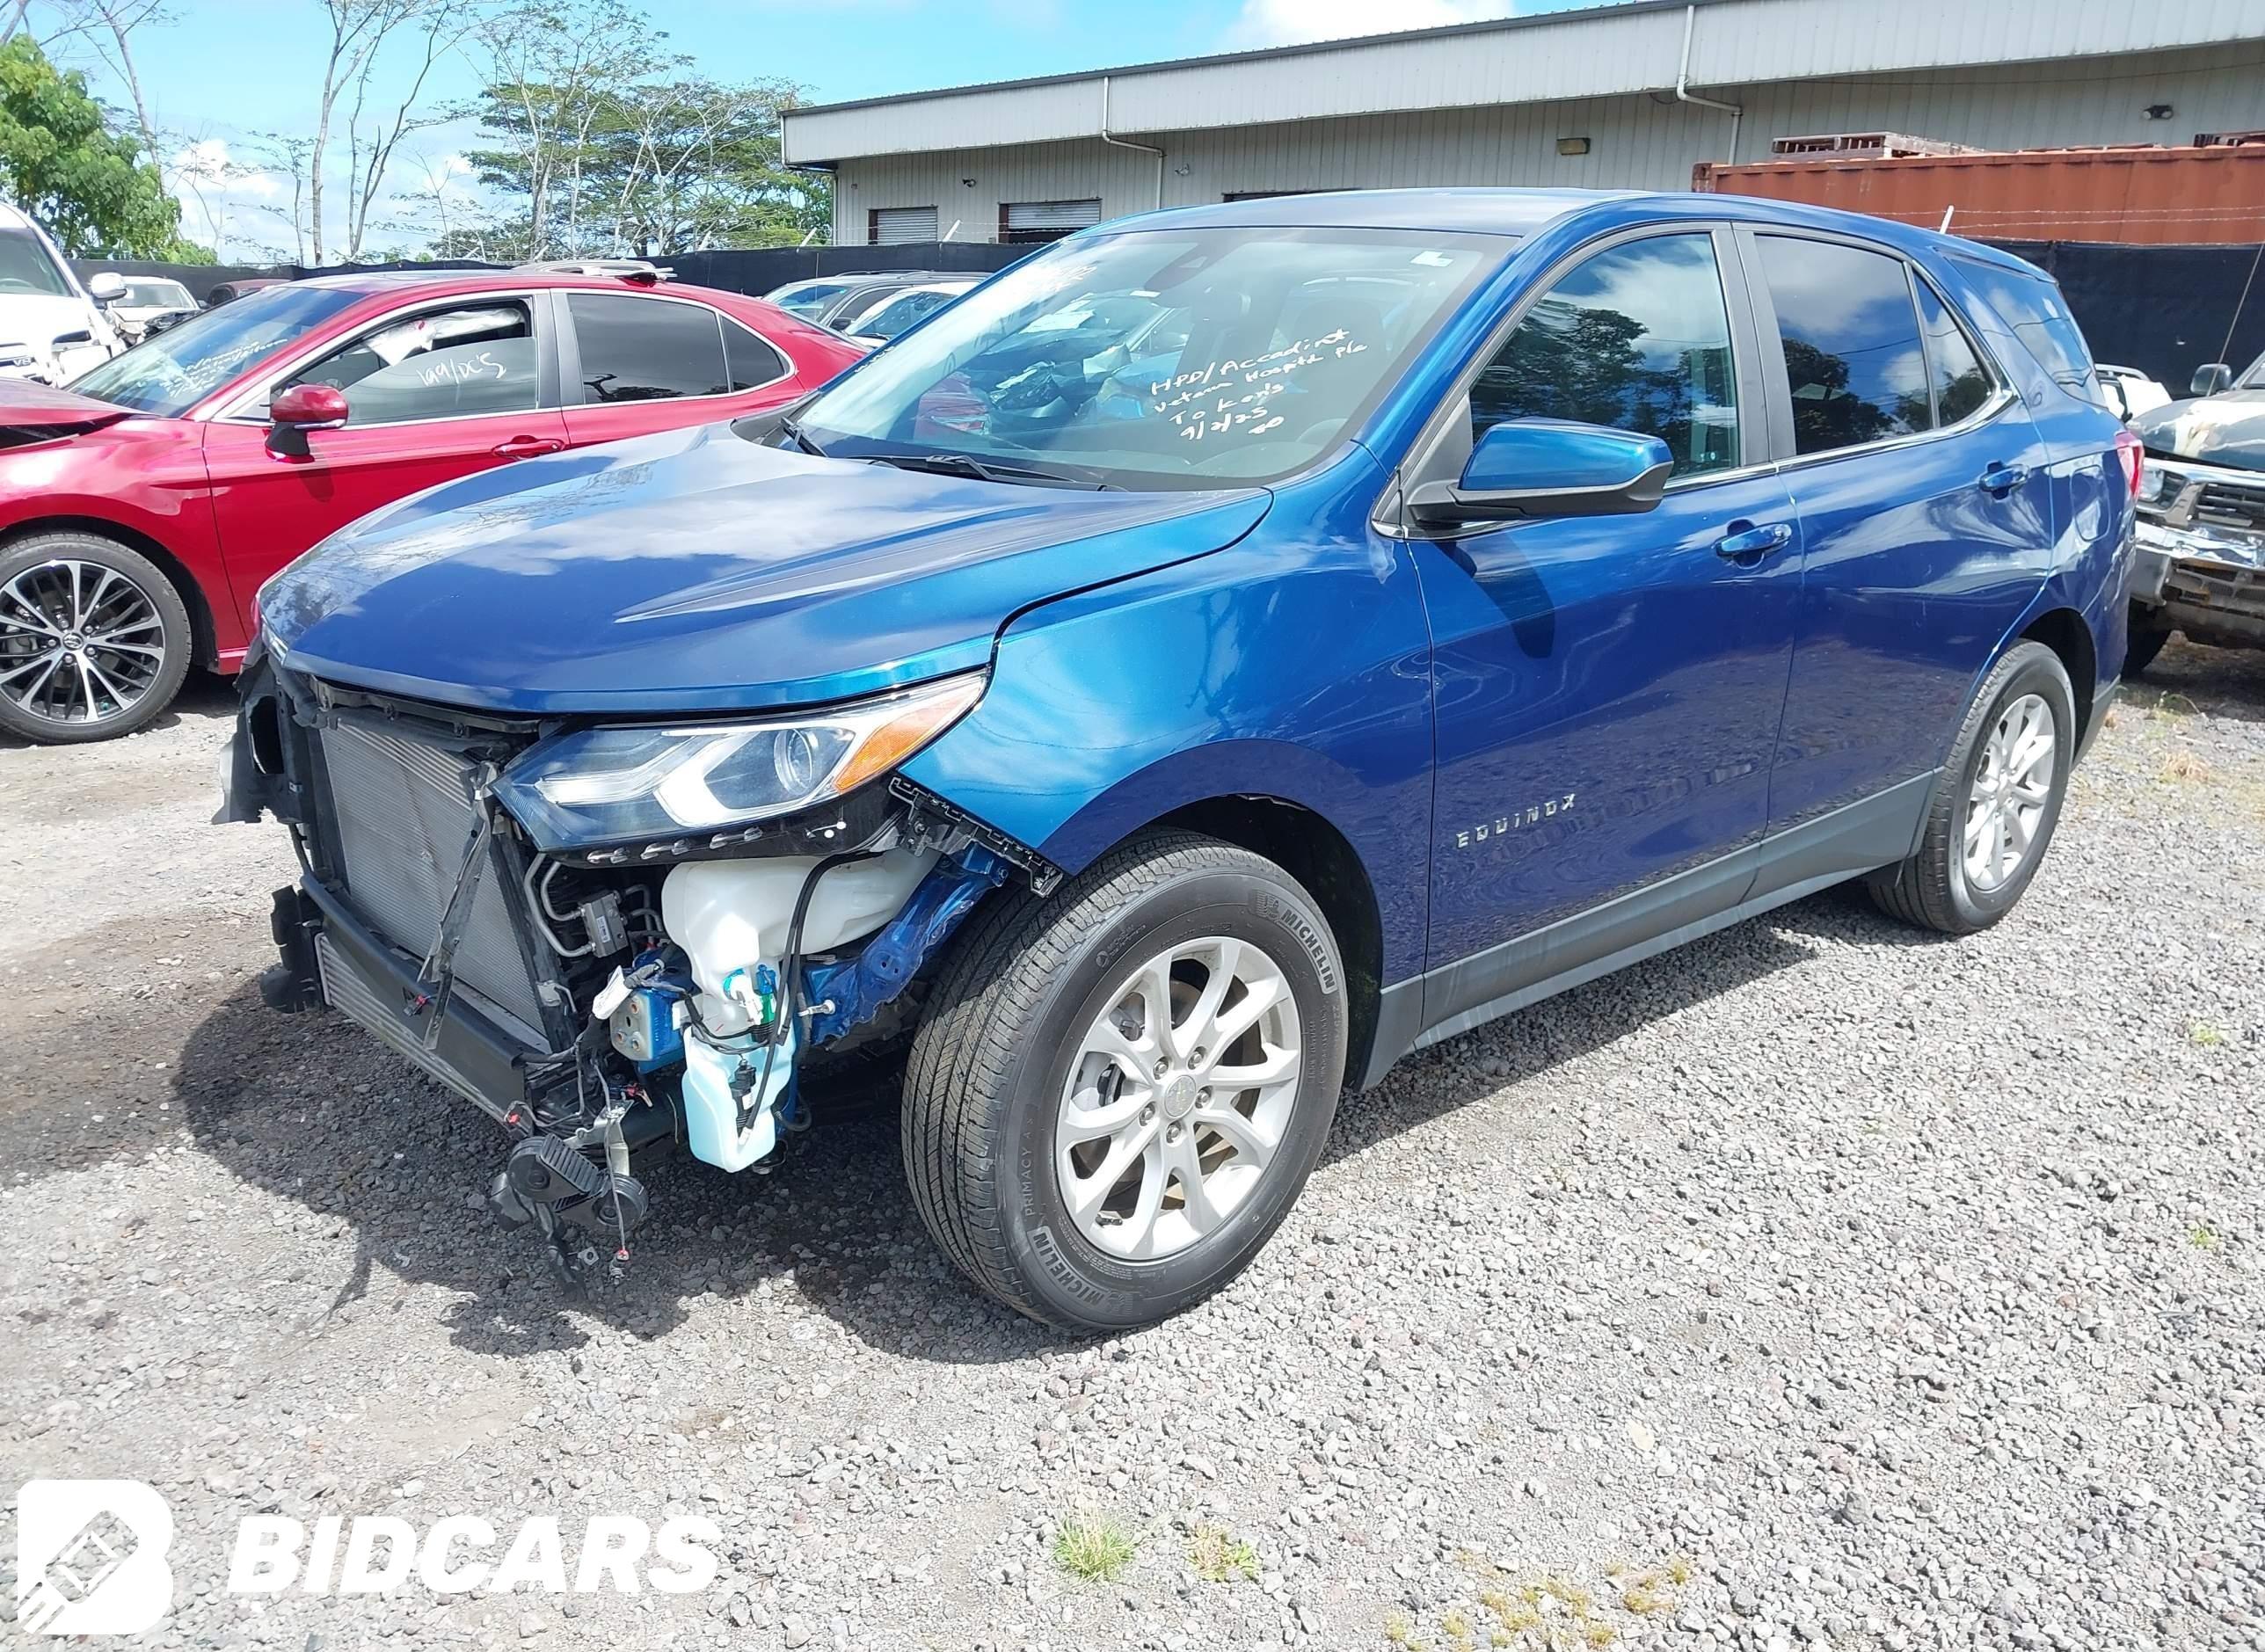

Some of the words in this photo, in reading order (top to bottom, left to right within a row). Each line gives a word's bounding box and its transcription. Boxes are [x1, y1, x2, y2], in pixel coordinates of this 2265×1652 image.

[1455, 793, 1576, 849] EQUINOX
[1281, 909, 1336, 989] MICHELIN
[1021, 1146, 1035, 1217] PRIMACY
[1033, 1233, 1103, 1306] MICHELIN
